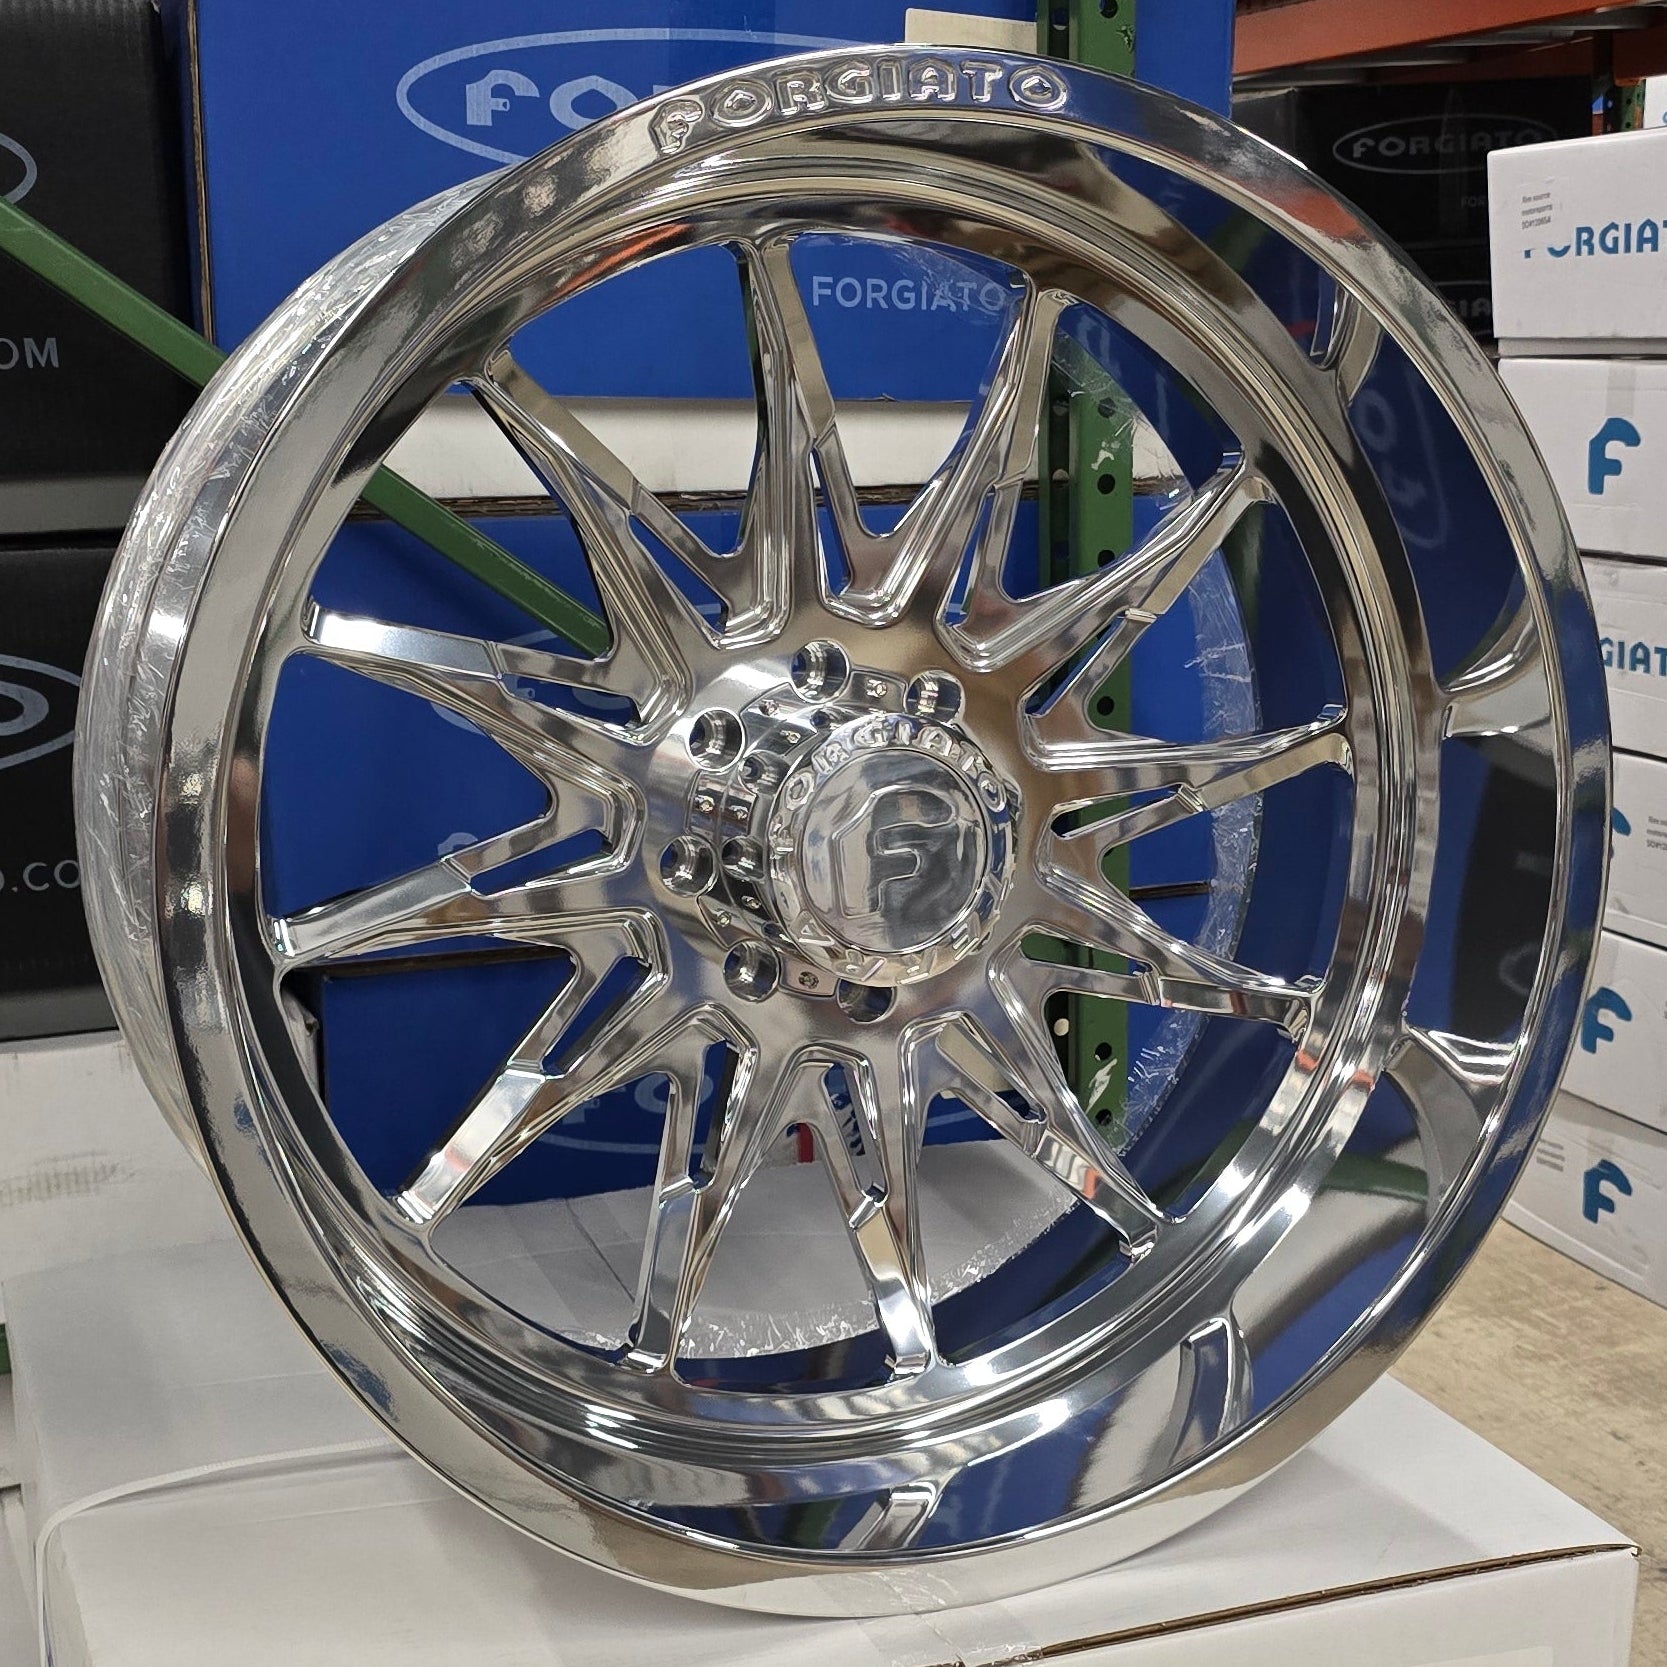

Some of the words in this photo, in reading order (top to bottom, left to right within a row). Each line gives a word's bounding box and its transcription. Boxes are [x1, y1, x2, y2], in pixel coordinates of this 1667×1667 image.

[466, 69, 672, 130] FO
[647, 58, 1069, 155] FORGIATO
[1353, 128, 1543, 158] FORGIATO
[1524, 218, 1667, 258] RGIA
[812, 276, 1007, 312] FORGIATO
[1588, 417, 1641, 495] F
[769, 715, 1008, 852] FORGIATO
[0, 860, 80, 893] .CO
[832, 784, 957, 920] F
[1581, 987, 1632, 1054] F
[1583, 1159, 1632, 1224] F
